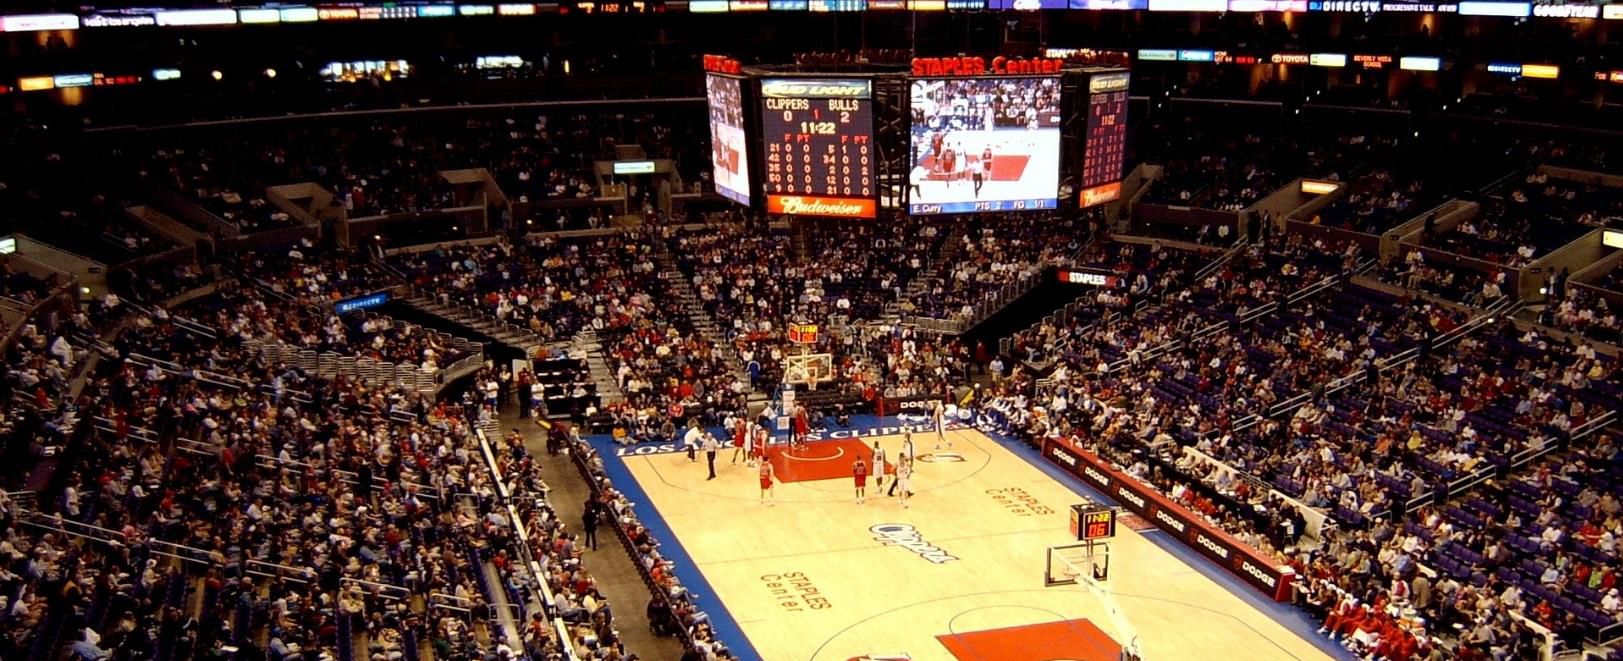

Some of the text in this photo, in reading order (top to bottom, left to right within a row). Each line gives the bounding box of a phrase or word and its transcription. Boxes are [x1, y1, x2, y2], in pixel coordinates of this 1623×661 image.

[1533, 4, 1599, 18] GOODYEAR
[1282, 54, 1309, 63] TOYOTA
[911, 56, 1063, 76] STAPLES Center
[808, 85, 866, 95] LIGHT
[766, 99, 859, 111] CLIPPERS BULLS
[783, 109, 850, 123] 0 1 2
[801, 122, 836, 134] 11:22
[784, 134, 792, 142] F
[797, 134, 810, 143] PT
[785, 144, 793, 152] 0
[803, 144, 810, 153] 0
[842, 145, 847, 154] 1
[860, 146, 868, 154] 0
[786, 154, 793, 163] 0
[803, 154, 811, 163] 0
[842, 156, 849, 165] 0
[861, 156, 868, 165] 0
[786, 164, 793, 172] 0
[804, 164, 811, 173] 0
[829, 165, 836, 174] 2
[843, 166, 850, 175] 0
[861, 167, 868, 175] 2
[787, 174, 794, 182] 0
[804, 174, 812, 183] 0
[826, 175, 836, 184] 12
[843, 176, 851, 185] 0
[862, 177, 869, 185] 0
[787, 184, 794, 192] 0
[805, 185, 812, 193] 0
[827, 186, 837, 194] 21
[844, 186, 851, 195] 0
[862, 187, 870, 196] 0
[780, 195, 863, 214] Budweiser
[922, 204, 943, 214] Curry
[975, 202, 990, 211] PTS
[1069, 271, 1106, 285] STAPLES
[616, 443, 676, 457] LOS
[1052, 447, 1076, 466] DODGE
[1084, 466, 1110, 487] DODGE
[985, 489, 1032, 517] Center
[1003, 487, 1055, 515] STAPLES
[1118, 487, 1145, 508] DODGE
[1087, 513, 1109, 523] 11:22
[1156, 510, 1184, 532] DODGE
[1088, 523, 1106, 537] 06
[1197, 534, 1228, 558] DODGE
[1241, 561, 1276, 587] DODGE
[760, 574, 804, 612] Center
[783, 571, 832, 610] STAPLES
